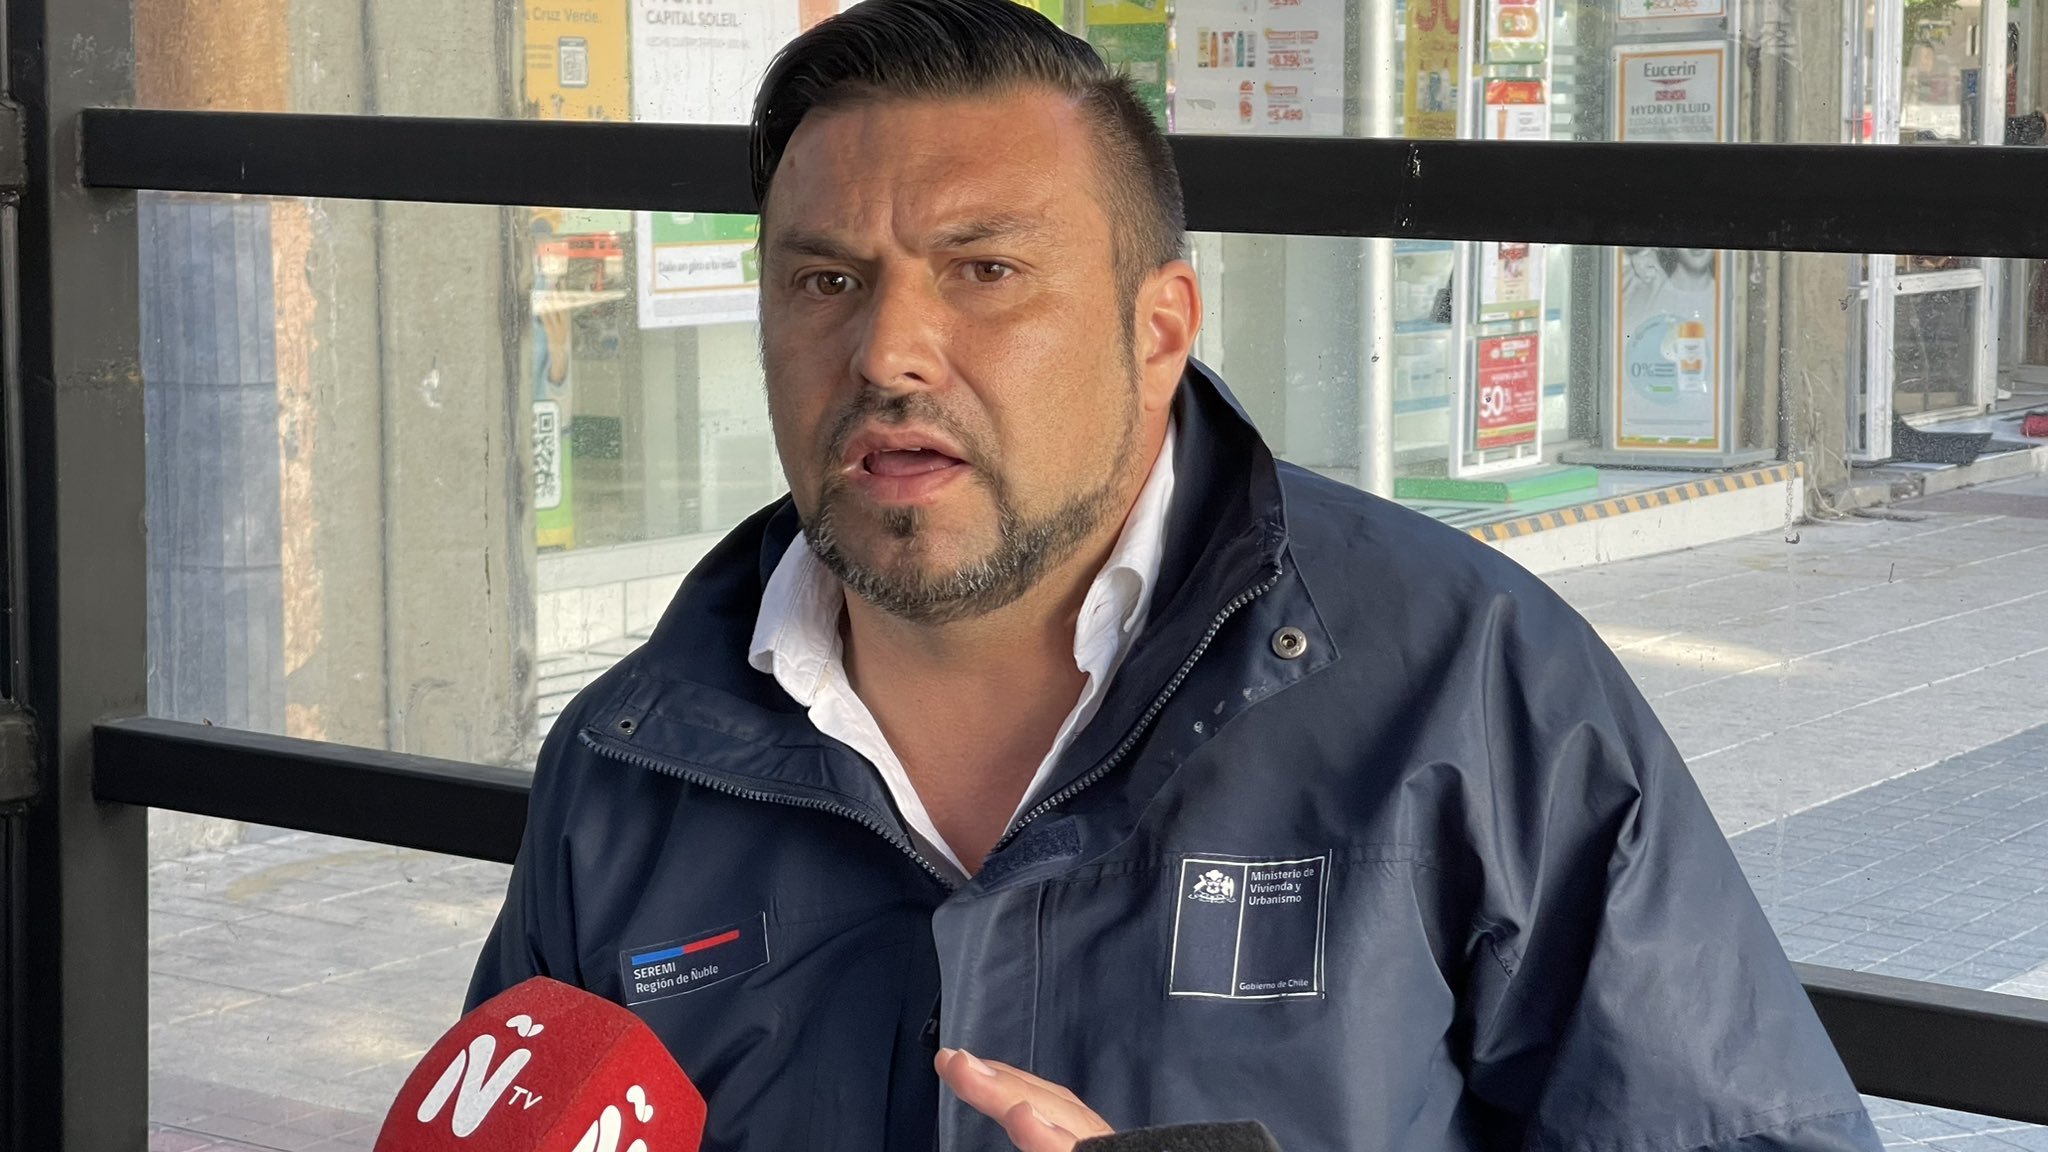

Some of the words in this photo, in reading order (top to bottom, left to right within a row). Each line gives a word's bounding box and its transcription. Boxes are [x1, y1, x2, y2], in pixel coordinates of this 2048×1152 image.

[533, 7, 561, 21] Cruz
[647, 10, 696, 25] CAPITAL
[1643, 61, 1697, 77] Eucerin
[1631, 104, 1673, 115] HYDRO
[1676, 103, 1711, 113] FLUID
[1251, 868, 1301, 881] Ministerio
[1303, 867, 1315, 877] de
[1250, 882, 1293, 893] Vivienda
[1294, 883, 1302, 893] y
[1249, 894, 1302, 906] Urbanismo
[633, 962, 676, 980] SEREMI
[636, 978, 674, 994] Región
[676, 974, 690, 984] de
[691, 965, 719, 981] Ñuble
[1239, 980, 1276, 990] Gobierno
[1277, 981, 1287, 989] de
[1288, 979, 1309, 988] Chile
[508, 1085, 543, 1110] TV
